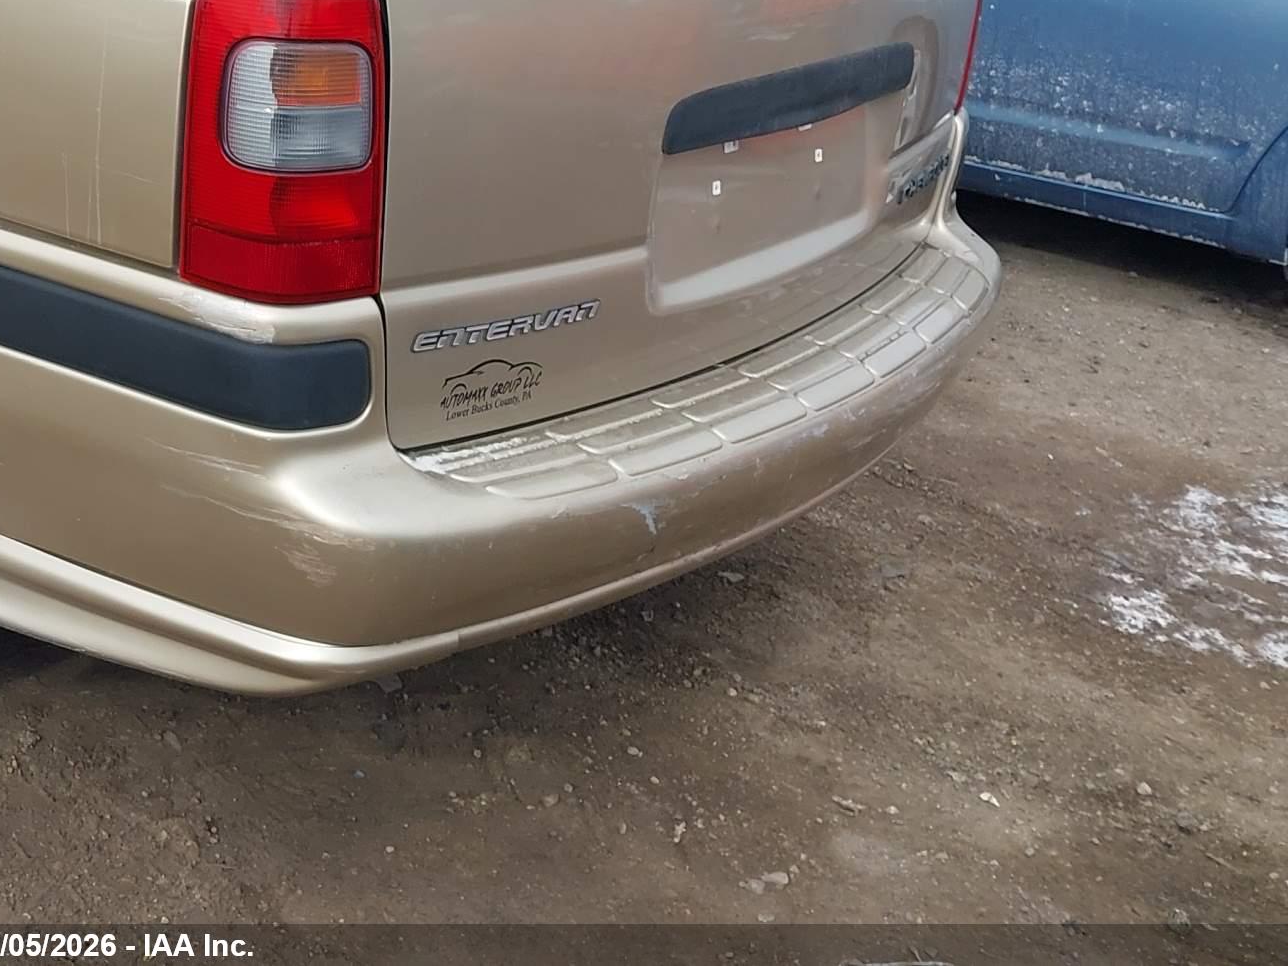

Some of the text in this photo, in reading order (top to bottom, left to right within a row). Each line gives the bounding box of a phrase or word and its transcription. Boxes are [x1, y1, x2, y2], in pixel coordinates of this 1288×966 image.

[410, 298, 601, 354] ENTERVAN
[440, 370, 543, 410] AUTOMAXX GROUP LLC
[445, 408, 470, 422] Lower
[471, 400, 493, 415] Bucks
[521, 389, 532, 402] PA
